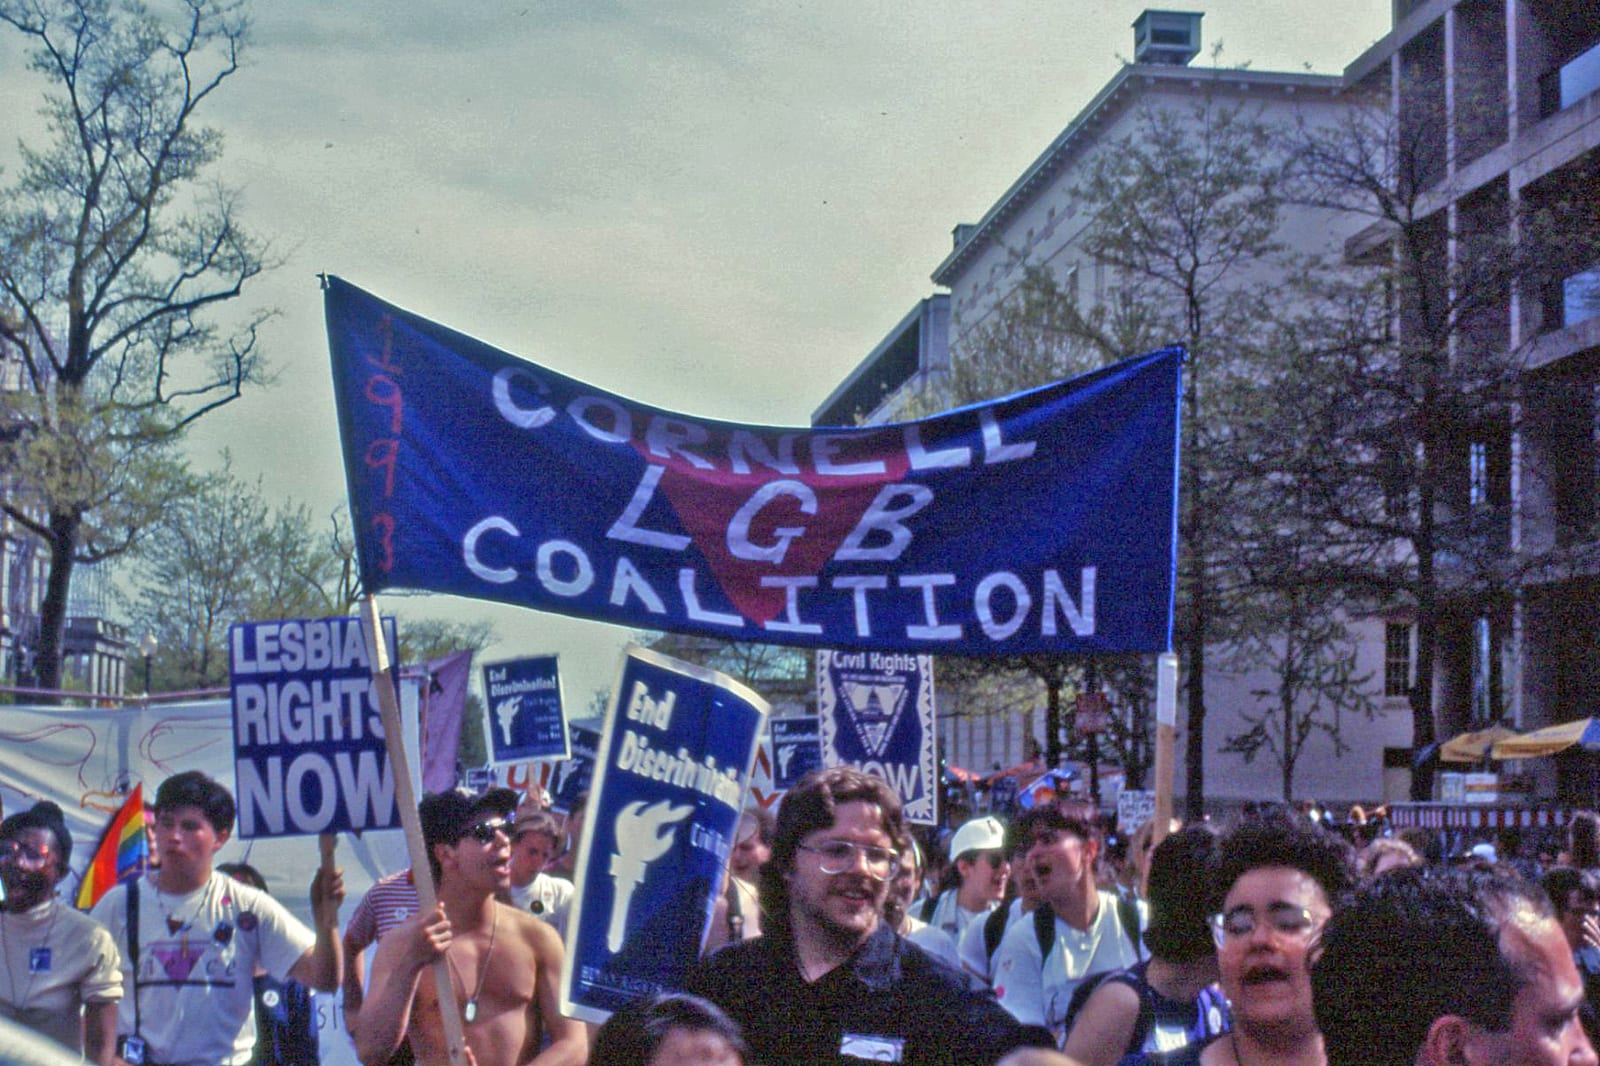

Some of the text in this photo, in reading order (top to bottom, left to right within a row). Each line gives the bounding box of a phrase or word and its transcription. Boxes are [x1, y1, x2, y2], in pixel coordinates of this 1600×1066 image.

[491, 366, 1037, 476] CORNELL
[463, 516, 1097, 641] COALITION
[489, 667, 507, 682] End
[832, 651, 917, 676] Civil Rights
[236, 678, 386, 747] RIGHTS
[627, 680, 676, 731] End
[238, 752, 397, 835] NOW
